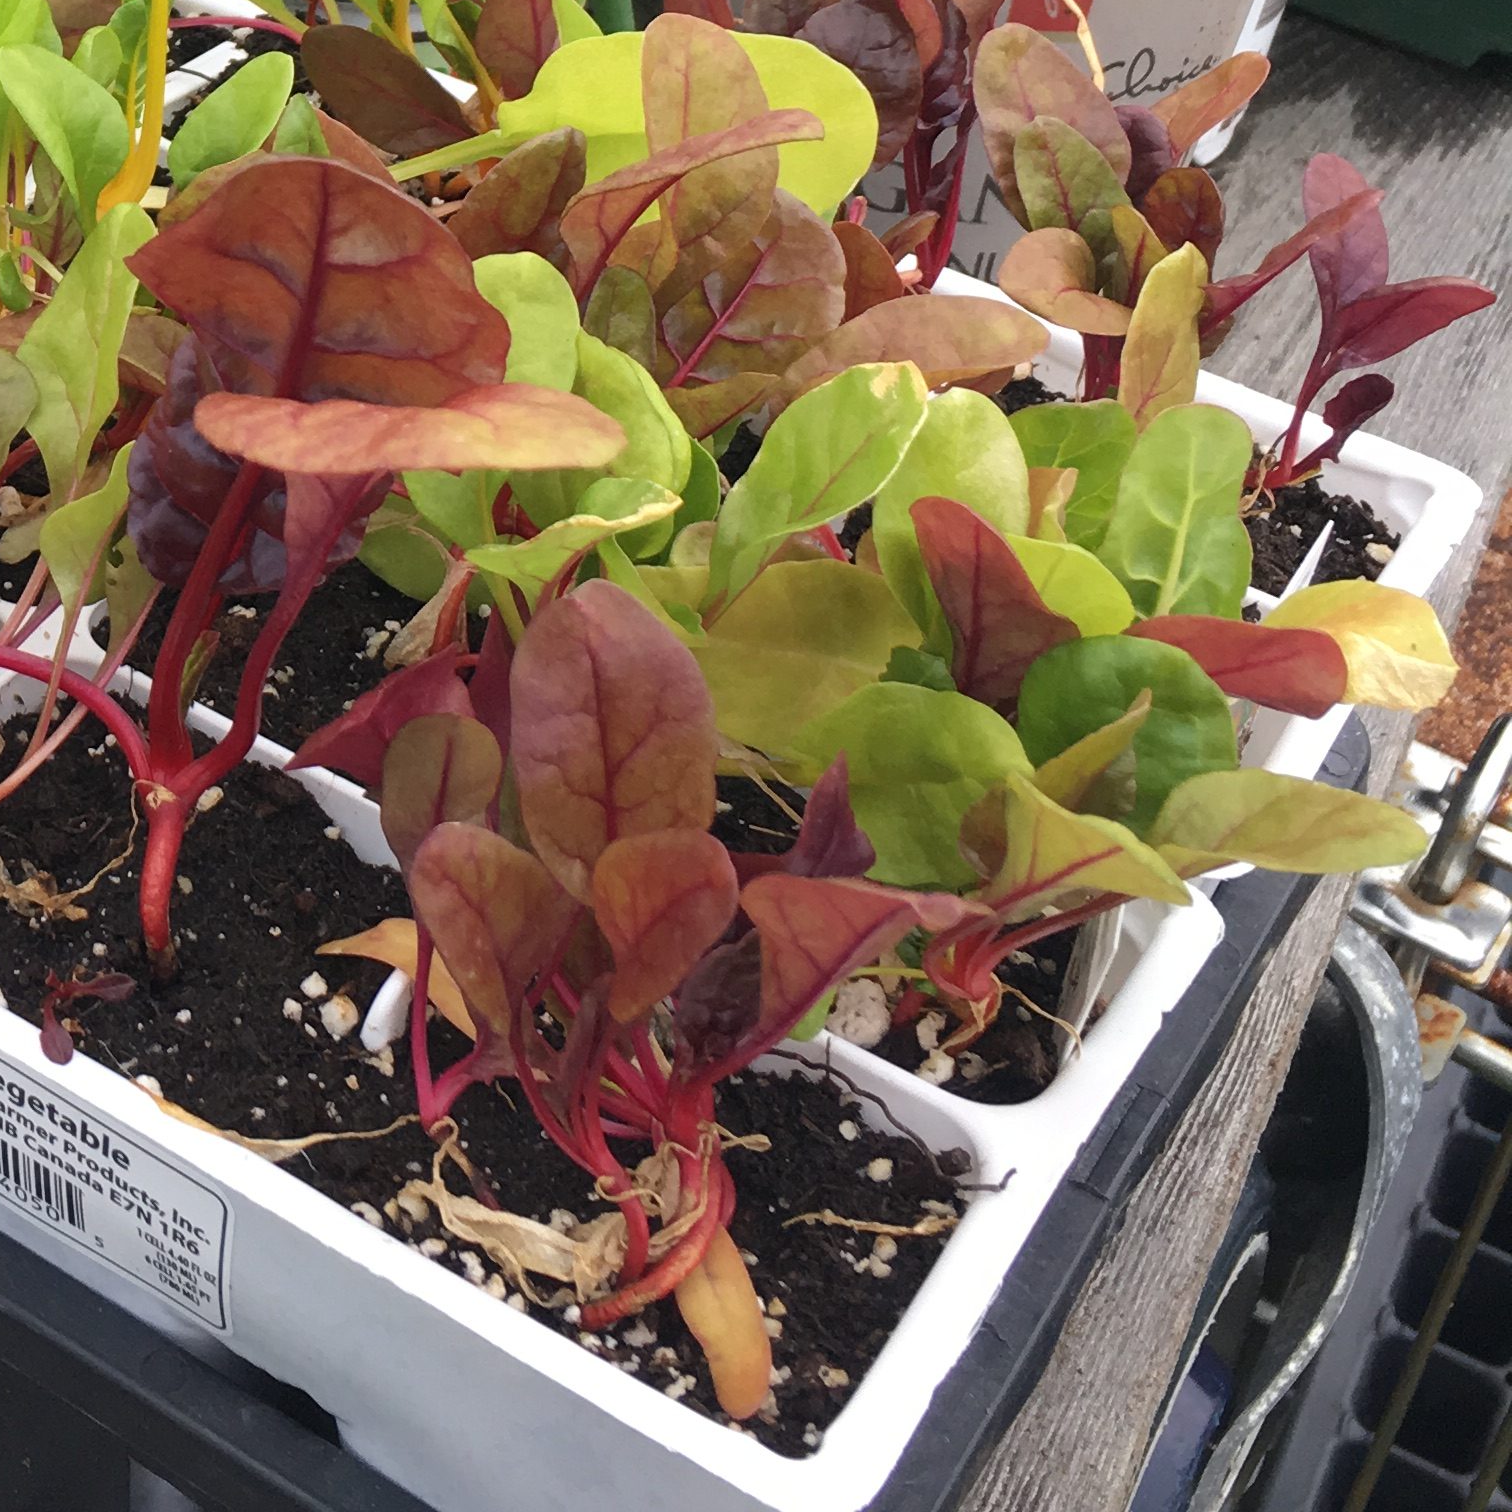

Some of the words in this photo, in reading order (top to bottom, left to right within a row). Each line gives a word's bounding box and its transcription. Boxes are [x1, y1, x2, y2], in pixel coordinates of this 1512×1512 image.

[23, 1133, 105, 1195] Canada
[109, 1188, 153, 1226] E7N
[159, 1220, 201, 1256] 1R6
[63, 1139, 165, 1217] Products,
[172, 1208, 211, 1246] Inc.
[94, 1235, 105, 1249] 5
